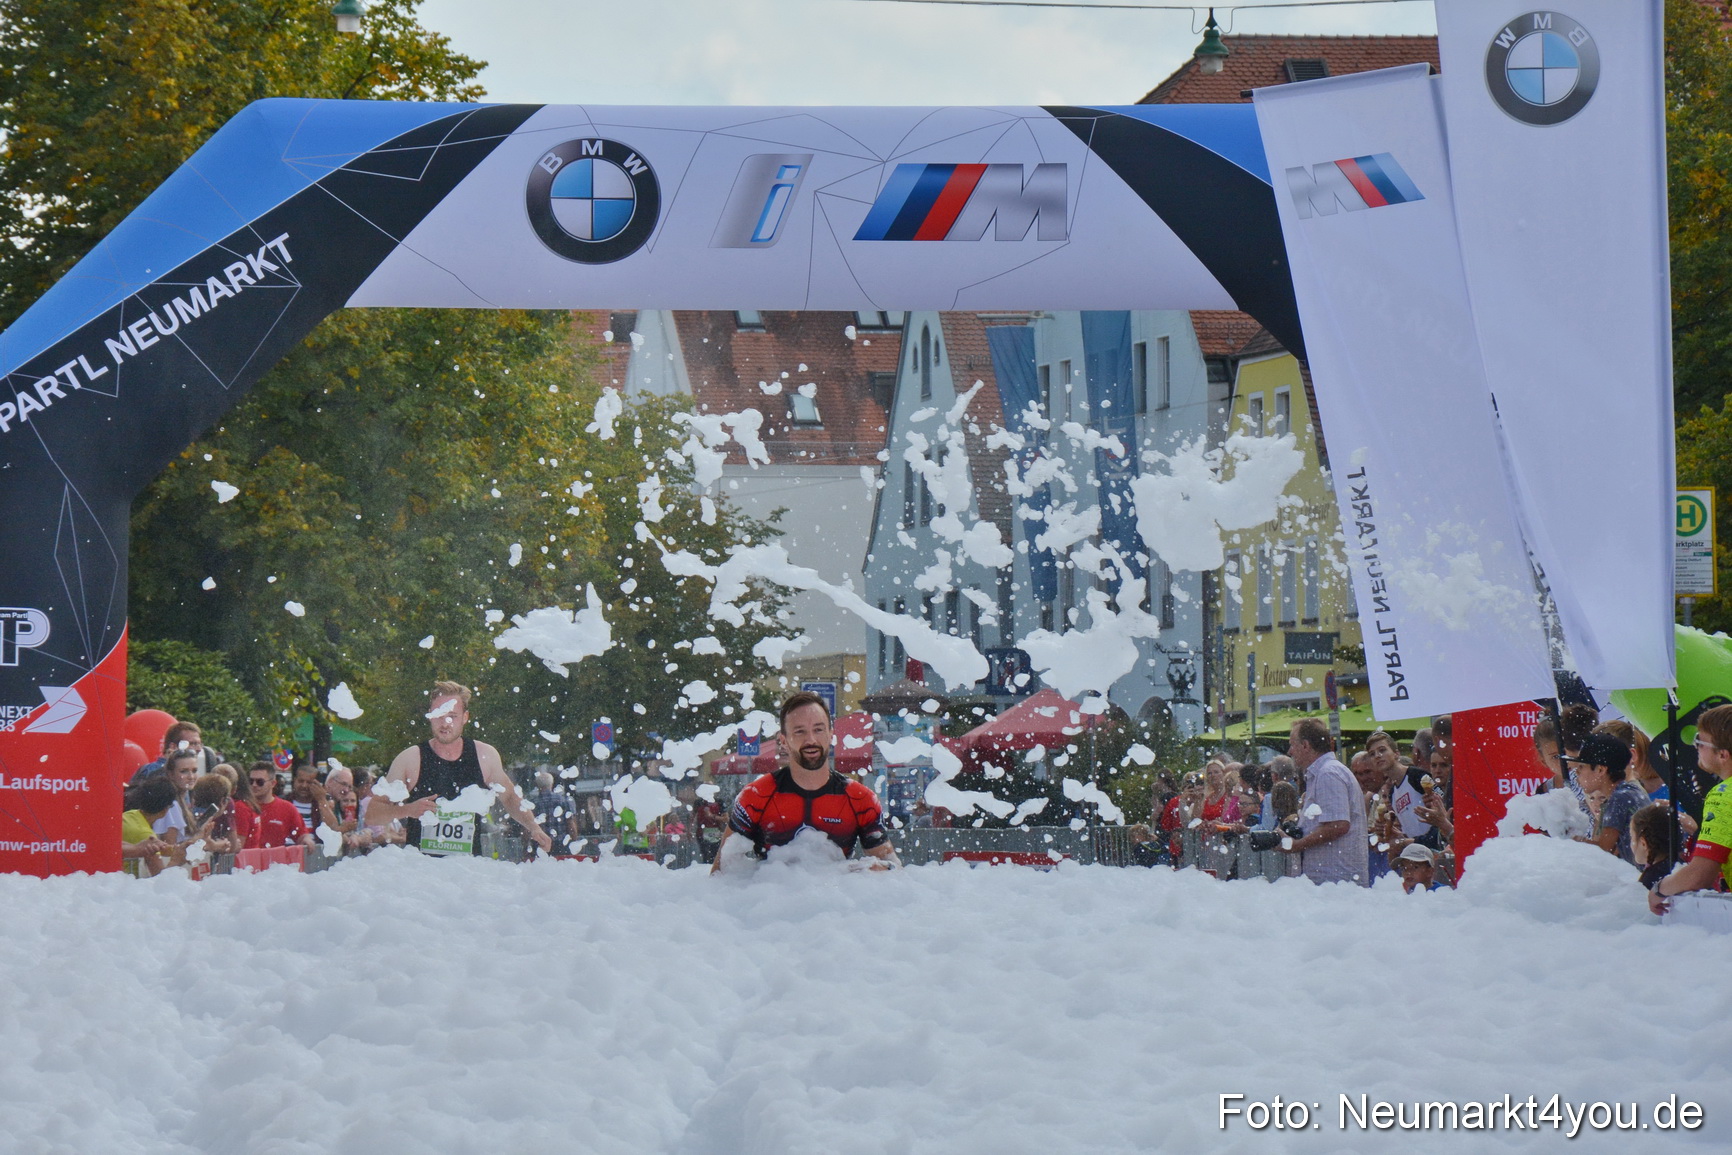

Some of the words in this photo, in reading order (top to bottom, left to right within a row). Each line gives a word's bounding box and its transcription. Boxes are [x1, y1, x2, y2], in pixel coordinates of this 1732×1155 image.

[0, 354, 109, 434] PARTL
[104, 232, 294, 365] NEUMARKT
[1288, 651, 1331, 660] TAIFUN
[1263, 664, 1303, 688] Restaurant
[1497, 725, 1519, 738] 100
[740, 745, 758, 753] TAXI
[0, 773, 88, 794] Laufsport
[433, 823, 463, 839] 108
[0, 839, 86, 854] mw-partl.de
[428, 840, 463, 850] FLORIAN
